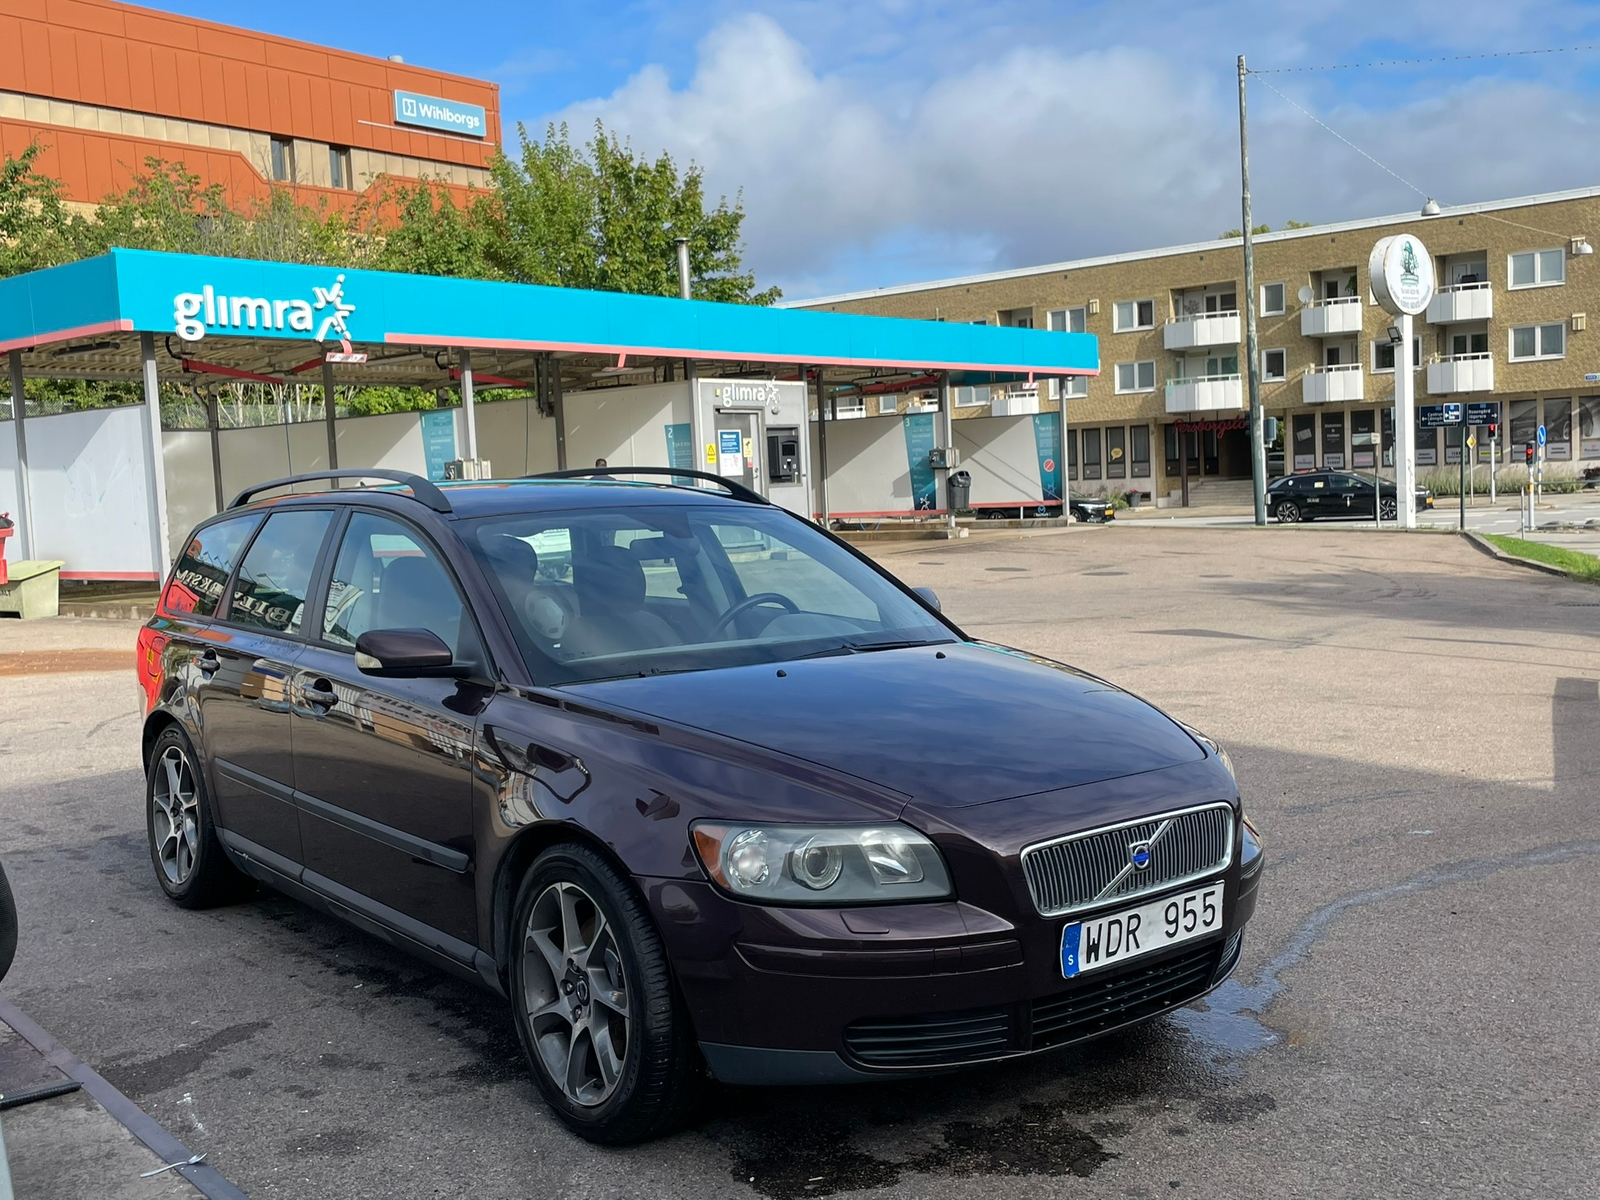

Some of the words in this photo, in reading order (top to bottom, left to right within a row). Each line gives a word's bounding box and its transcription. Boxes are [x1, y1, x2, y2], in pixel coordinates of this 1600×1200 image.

[419, 102, 480, 129] Wihlborgs
[174, 285, 313, 341] glimra
[722, 383, 765, 407] glimra
[904, 418, 911, 427] 3
[1035, 416, 1040, 426] 4
[668, 427, 673, 438] 2
[1086, 912, 1142, 964] WDR
[1164, 890, 1216, 938] 955
[1067, 954, 1074, 966] S
